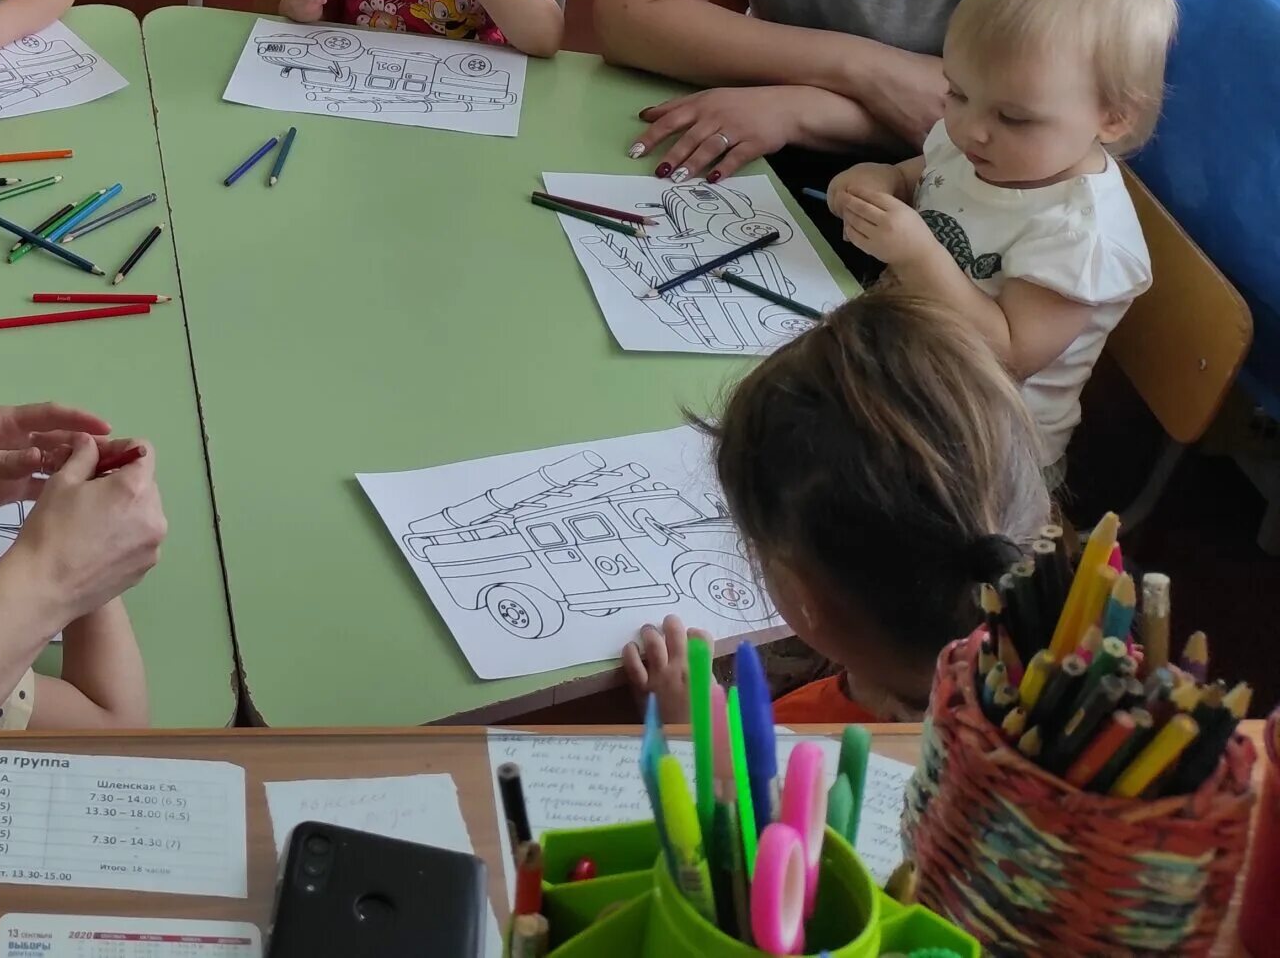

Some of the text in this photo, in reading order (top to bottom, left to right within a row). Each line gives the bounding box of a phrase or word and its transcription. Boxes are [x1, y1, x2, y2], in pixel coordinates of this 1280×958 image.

[595, 553, 640, 576] 01
[13, 754, 70, 769] группа
[97, 780, 155, 790] Шленская
[90, 793, 114, 802] 7.30
[127, 795, 157, 805] 14.00
[85, 806, 116, 816] 13.30
[130, 809, 161, 819] 18.00
[92, 835, 117, 845] 7.30
[130, 837, 162, 847] 14.30
[165, 839, 181, 850] (7)
[132, 865, 143, 873] 18
[12, 870, 72, 881] 13.30-15.00
[8, 929, 19, 938] 13
[68, 931, 93, 940] 2020
[8, 941, 50, 950] ВЫБОРЫ
